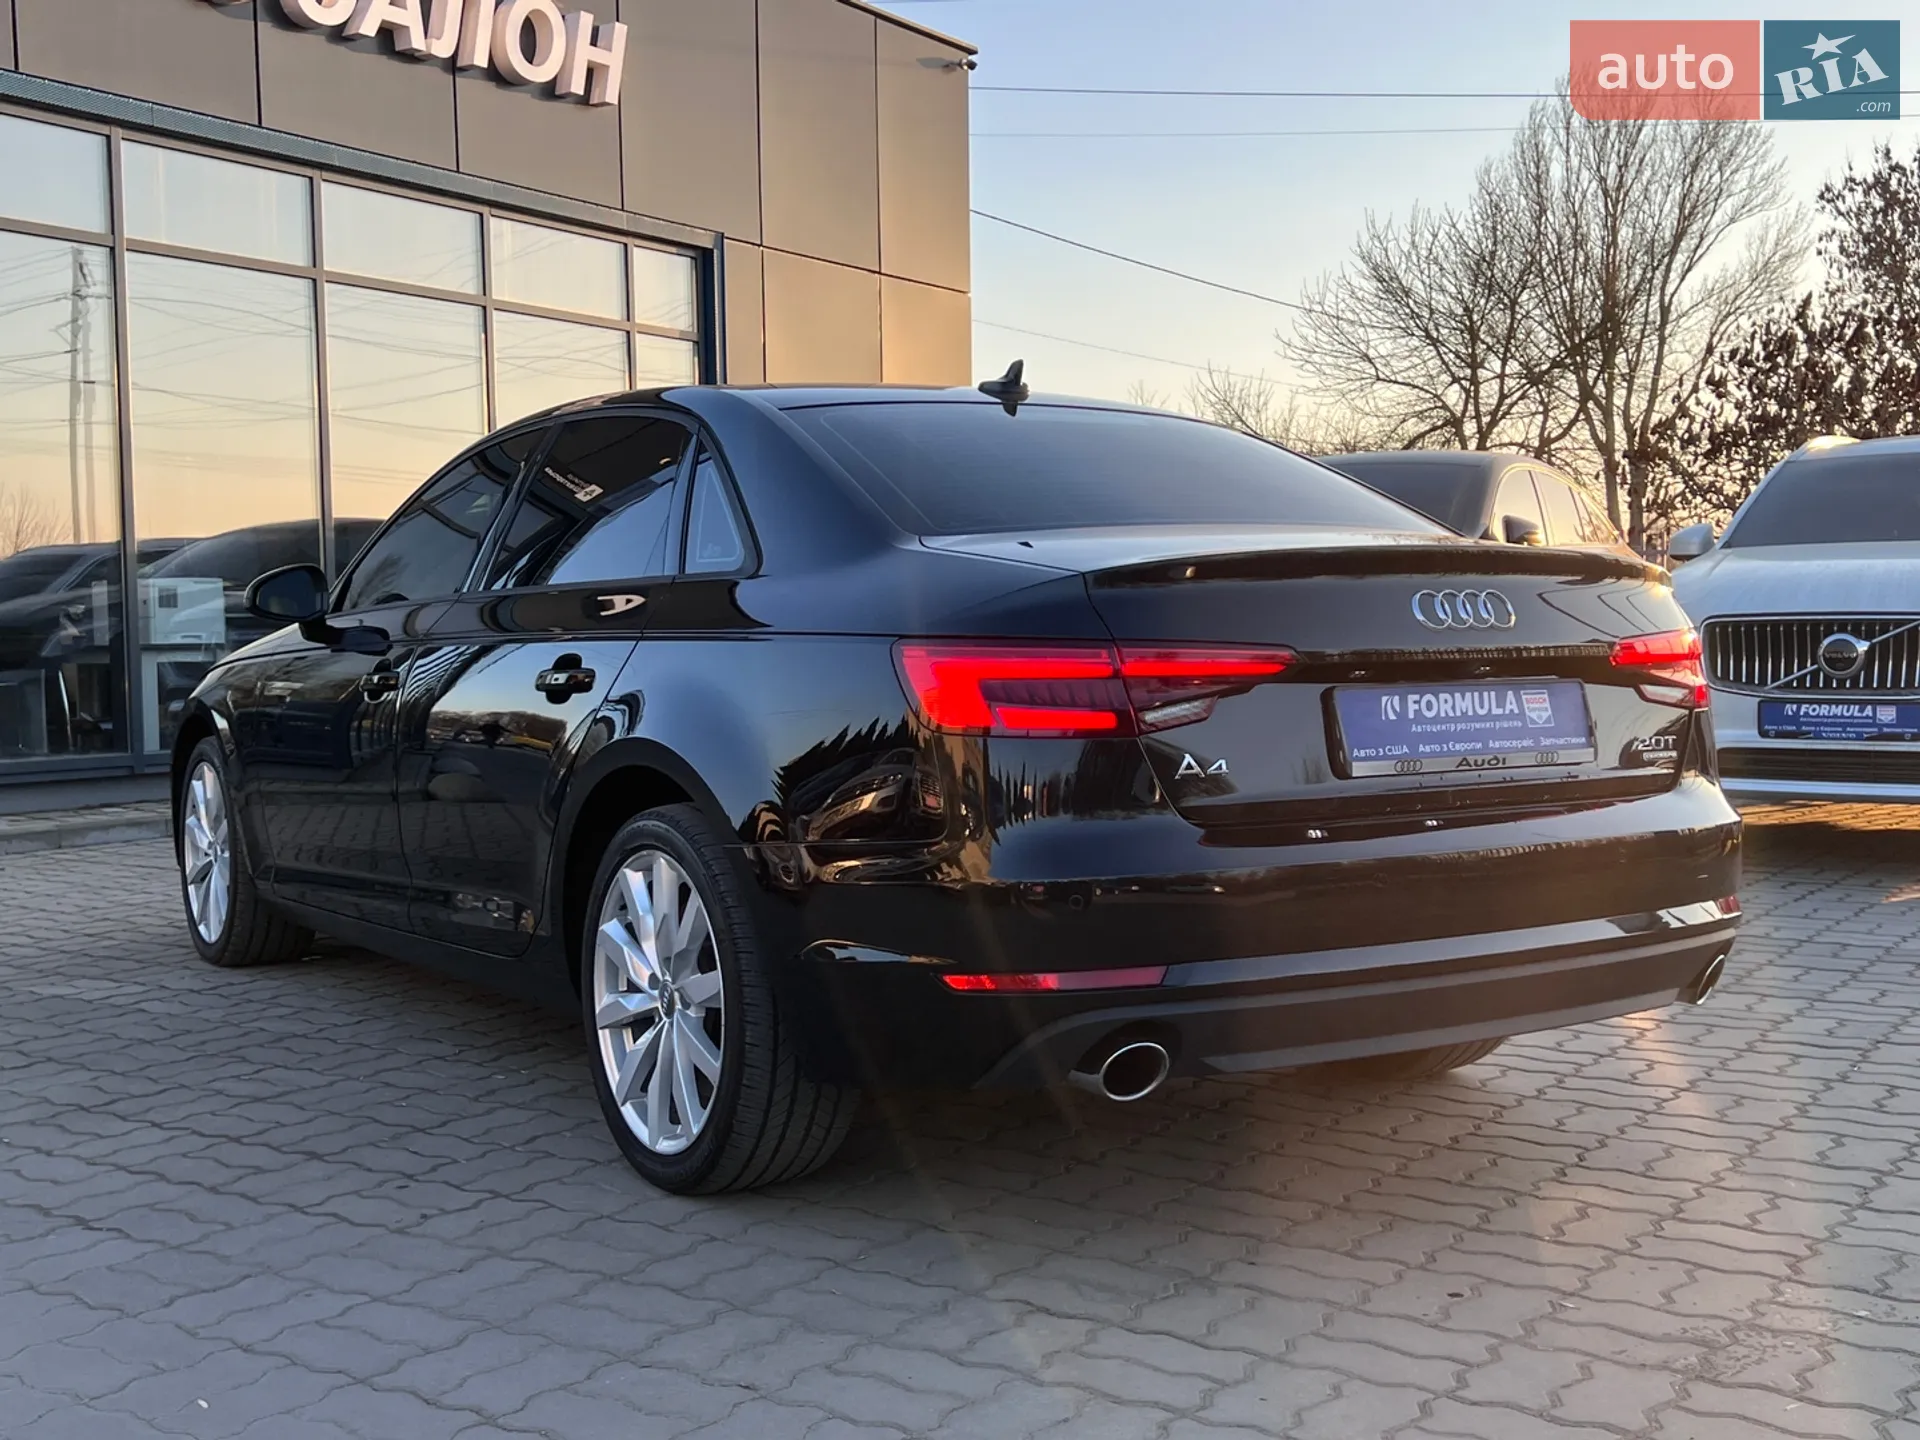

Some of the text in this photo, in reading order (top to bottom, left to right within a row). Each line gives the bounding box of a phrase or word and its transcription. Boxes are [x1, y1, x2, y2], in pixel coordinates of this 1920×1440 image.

[281, 0, 628, 107] АЛОН
[1407, 690, 1519, 719] FORMULA
[1525, 696, 1547, 705] BOSCH
[1800, 704, 1873, 717] FORMULA
[1411, 722, 1456, 733] Автоцентр
[1495, 720, 1522, 731] рішень
[1418, 743, 1441, 753] Авто
[1448, 741, 1482, 752] Європи
[1488, 738, 1535, 751] Автосервіс
[1540, 736, 1587, 747] Запчастини
[1353, 748, 1376, 758] Авто
[1385, 745, 1410, 755] США
[1174, 753, 1229, 780] A4
[1455, 755, 1507, 768] Audi
